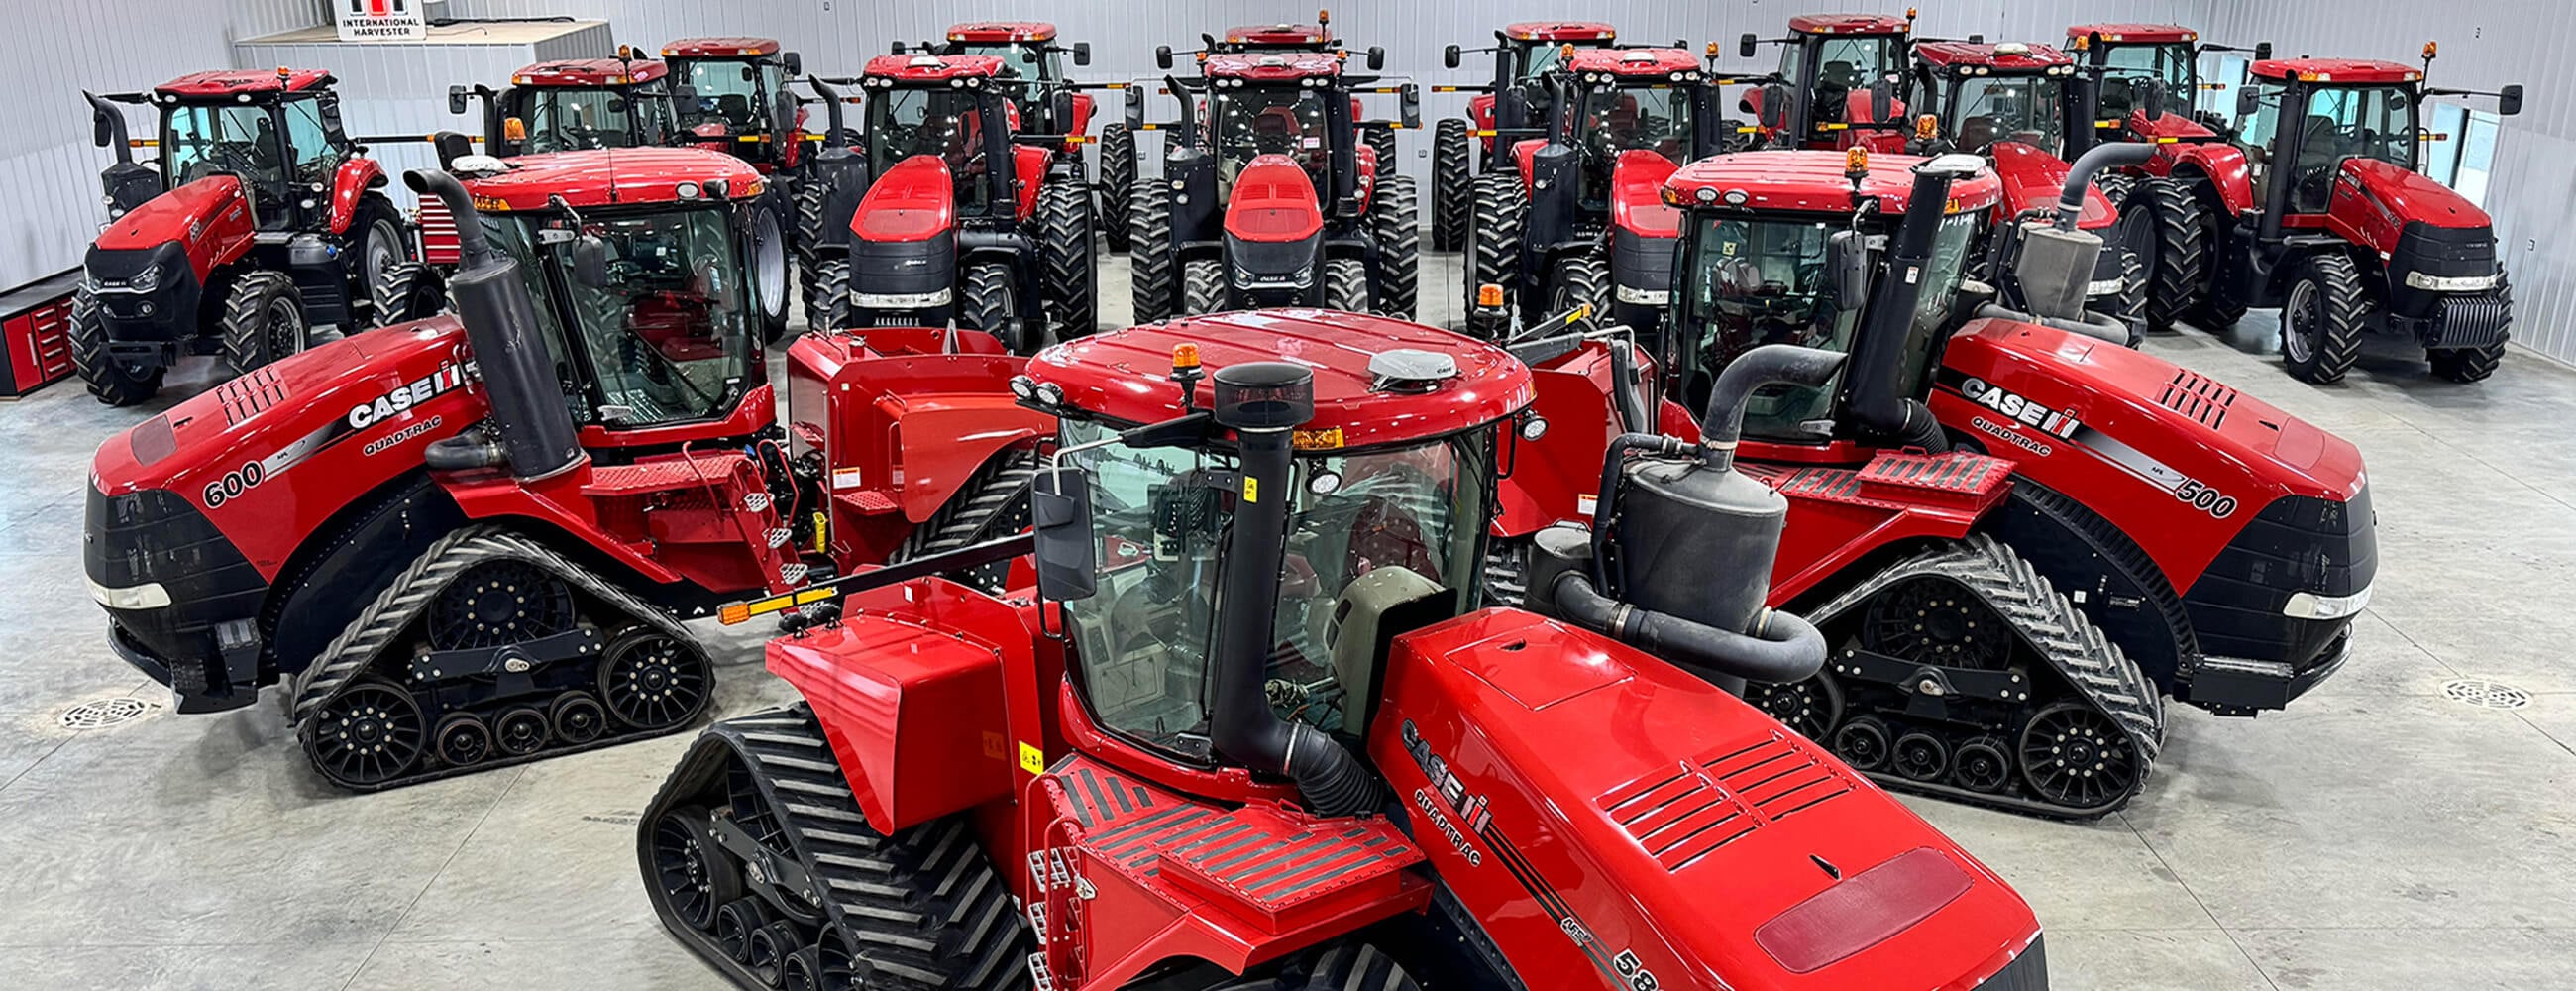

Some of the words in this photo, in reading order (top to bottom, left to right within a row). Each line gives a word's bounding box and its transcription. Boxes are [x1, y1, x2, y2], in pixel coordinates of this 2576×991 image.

[342, 18, 419, 28] INTERNATIONAL
[349, 377, 433, 429] CASE
[1962, 378, 2048, 426] CASE
[363, 415, 442, 456] QUADTRAC
[1971, 416, 2052, 457] QUADTRAC
[203, 460, 264, 509] 600
[2175, 478, 2237, 519] 500
[1401, 718, 1465, 808] CASE
[1414, 788, 1481, 867] QUADTRAC
[1613, 948, 1664, 991] 58
